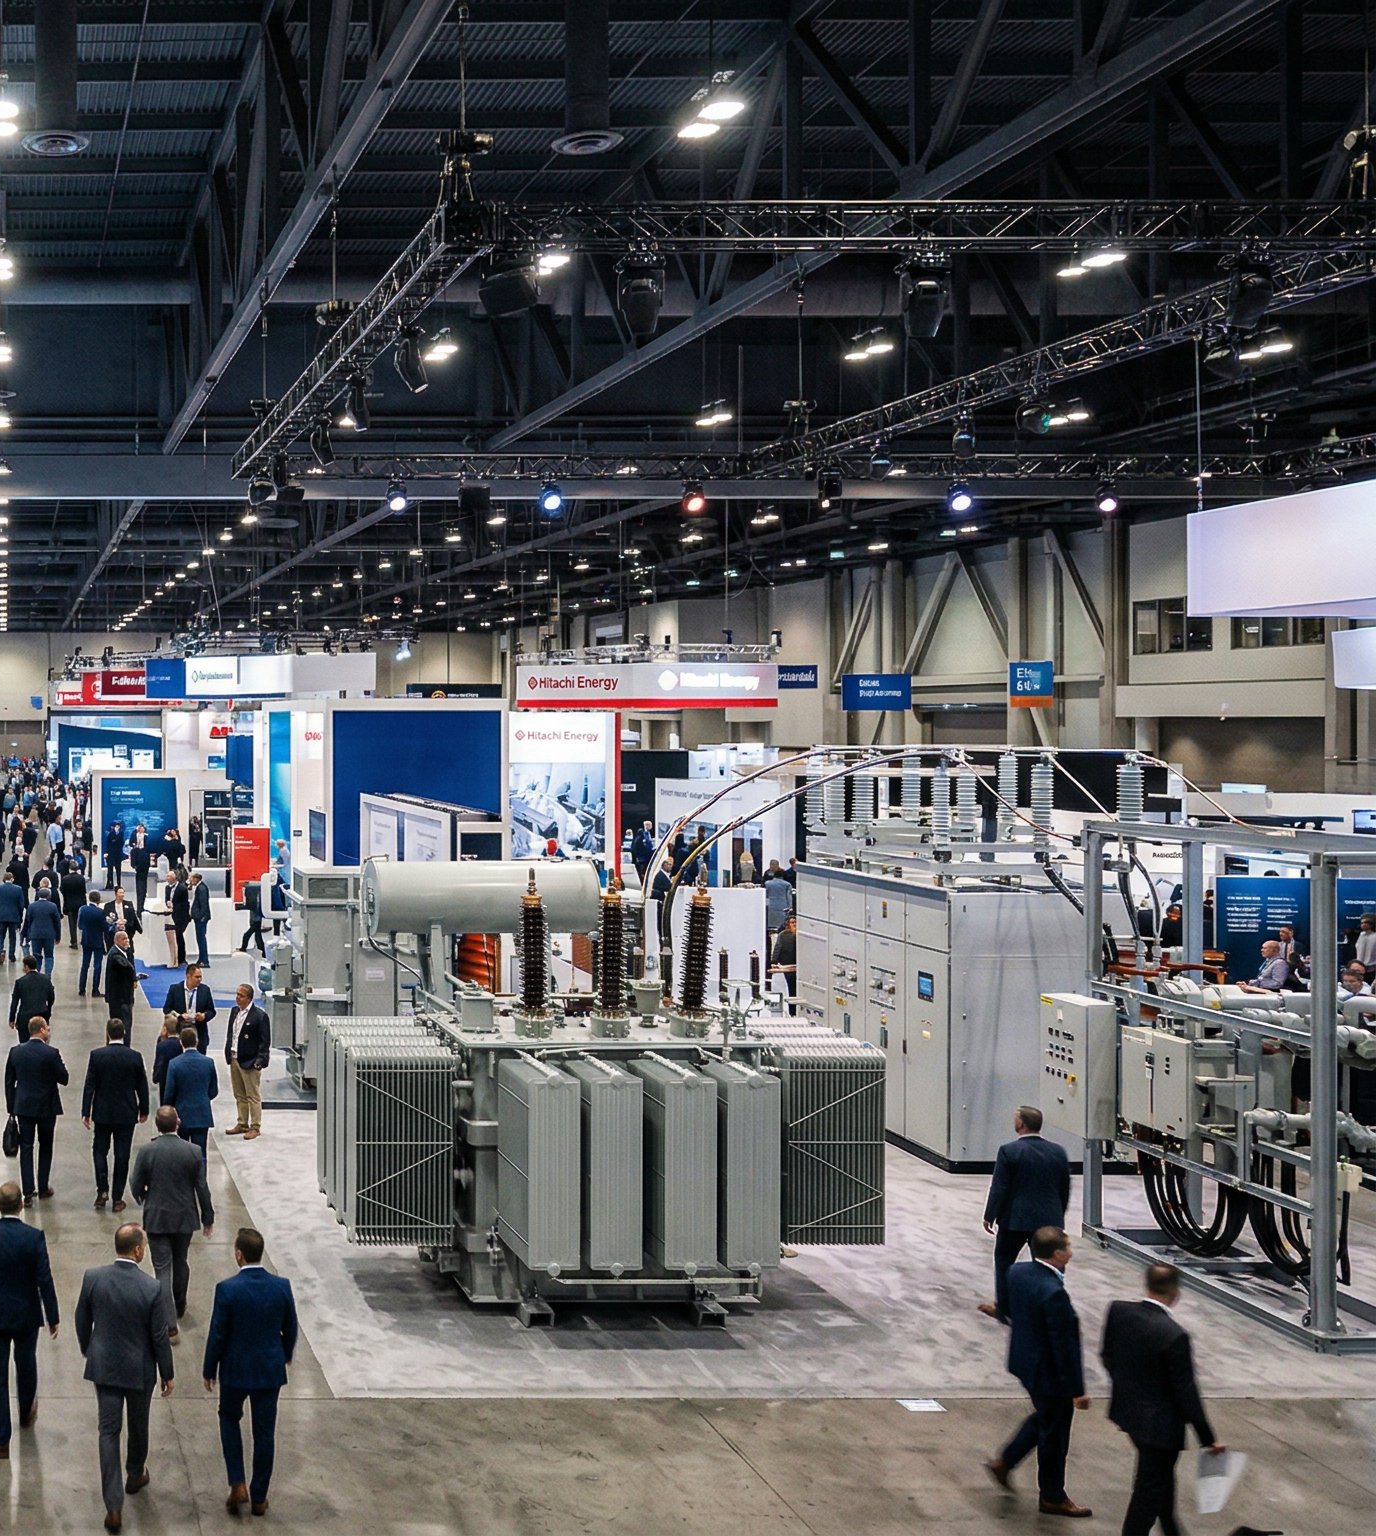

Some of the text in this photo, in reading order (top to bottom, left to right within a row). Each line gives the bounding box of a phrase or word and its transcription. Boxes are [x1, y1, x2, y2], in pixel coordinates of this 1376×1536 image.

[539, 676, 619, 691] Hitachi Energy
[527, 731, 599, 742] Hitachi Energy
